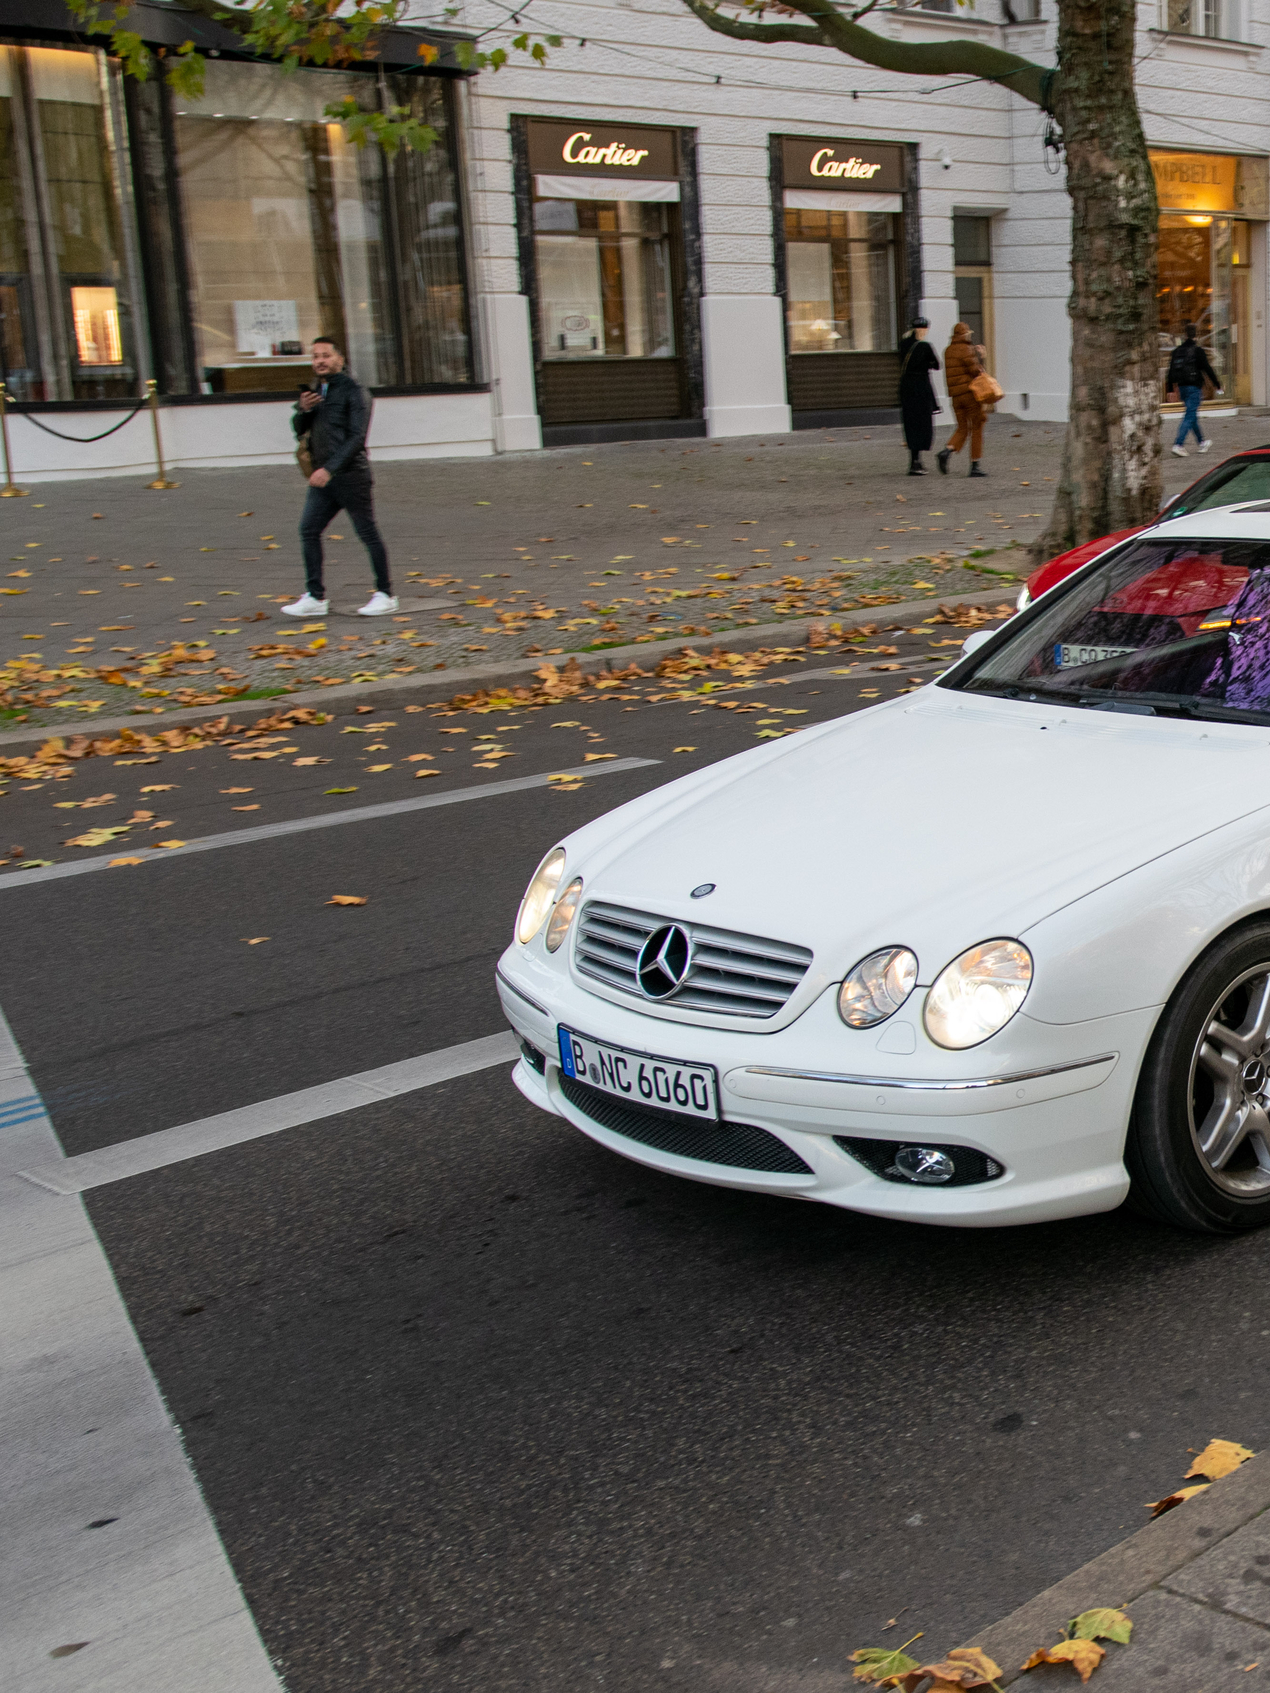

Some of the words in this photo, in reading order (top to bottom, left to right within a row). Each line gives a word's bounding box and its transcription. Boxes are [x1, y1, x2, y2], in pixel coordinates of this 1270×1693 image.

[562, 132, 649, 166] Cartier
[809, 148, 882, 179] Cartier
[1152, 161, 1221, 185] MPBELL
[1062, 647, 1071, 664] B
[571, 1038, 587, 1077] B
[598, 1050, 633, 1093] NC
[638, 1063, 710, 1112] 6060
